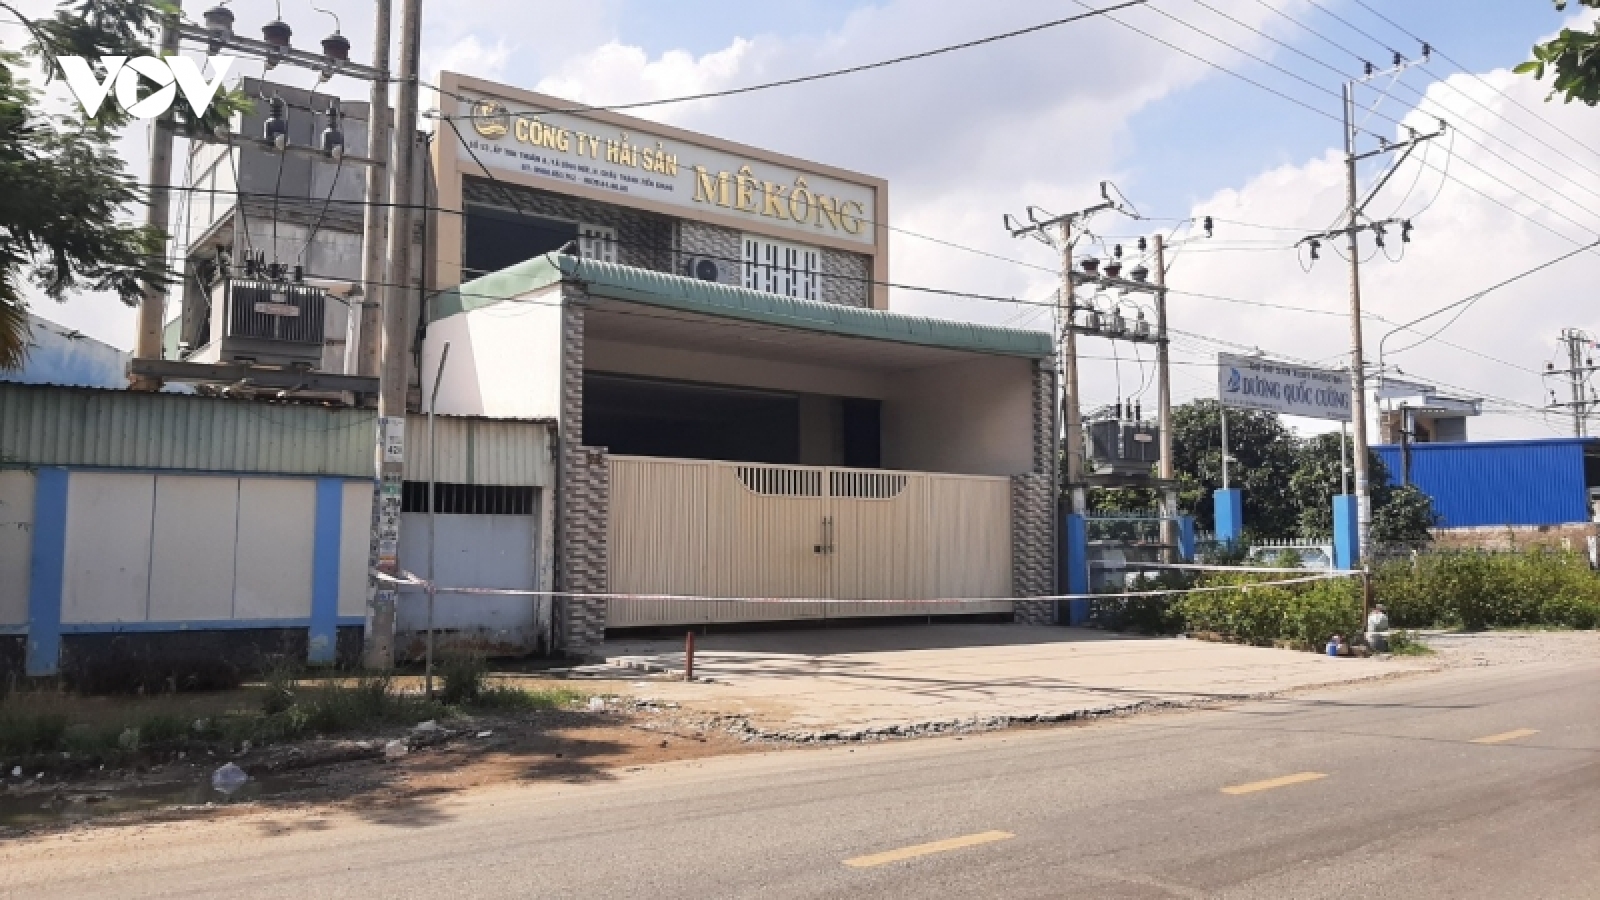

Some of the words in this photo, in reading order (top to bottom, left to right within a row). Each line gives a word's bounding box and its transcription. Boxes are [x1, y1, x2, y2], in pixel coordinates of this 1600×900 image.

[514, 115, 569, 152] CÔNG
[575, 132, 600, 160] TY
[606, 131, 637, 168] HẢI
[641, 141, 678, 177] SẢN
[692, 164, 867, 235] MÊKÔNG
